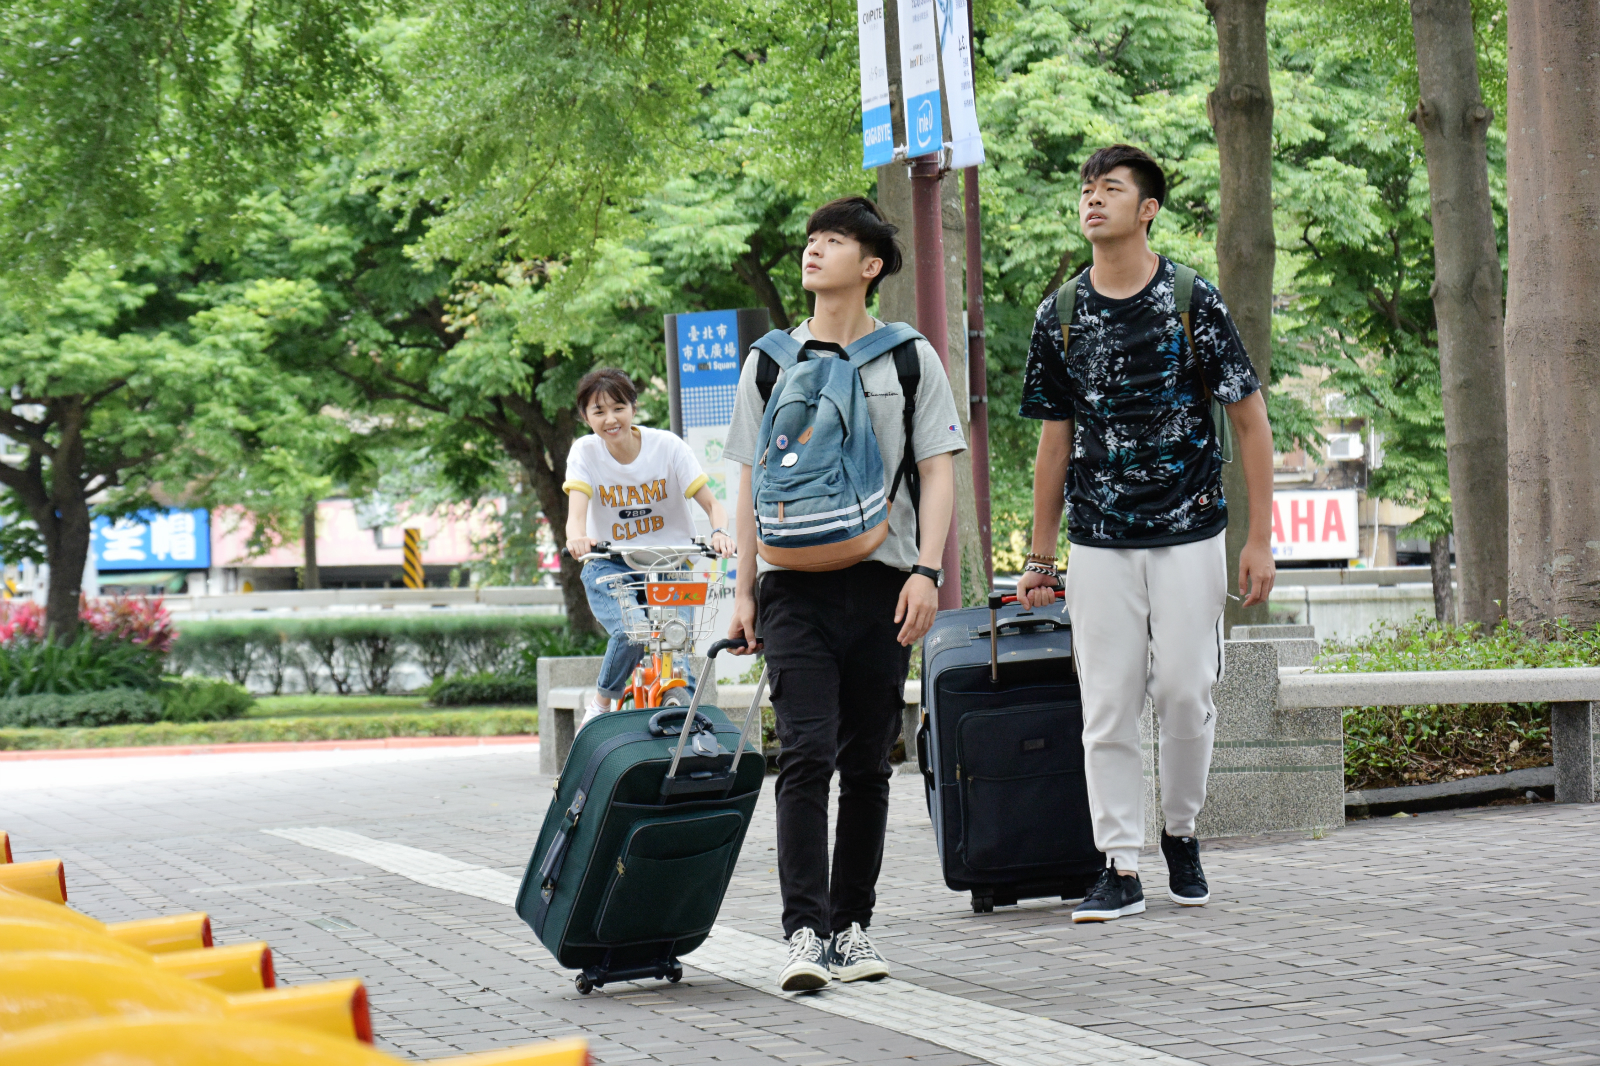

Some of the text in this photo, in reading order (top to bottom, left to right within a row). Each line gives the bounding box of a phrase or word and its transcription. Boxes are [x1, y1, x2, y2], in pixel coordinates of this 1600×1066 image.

[864, 122, 891, 147] GIGABYTE
[688, 323, 728, 342] 臺北市
[682, 342, 736, 360] 市民廣場
[682, 362, 696, 374] City
[713, 361, 737, 371] Square
[599, 478, 668, 508] MIAMI
[89, 511, 197, 562] 全帽
[612, 515, 665, 541] CLUB
